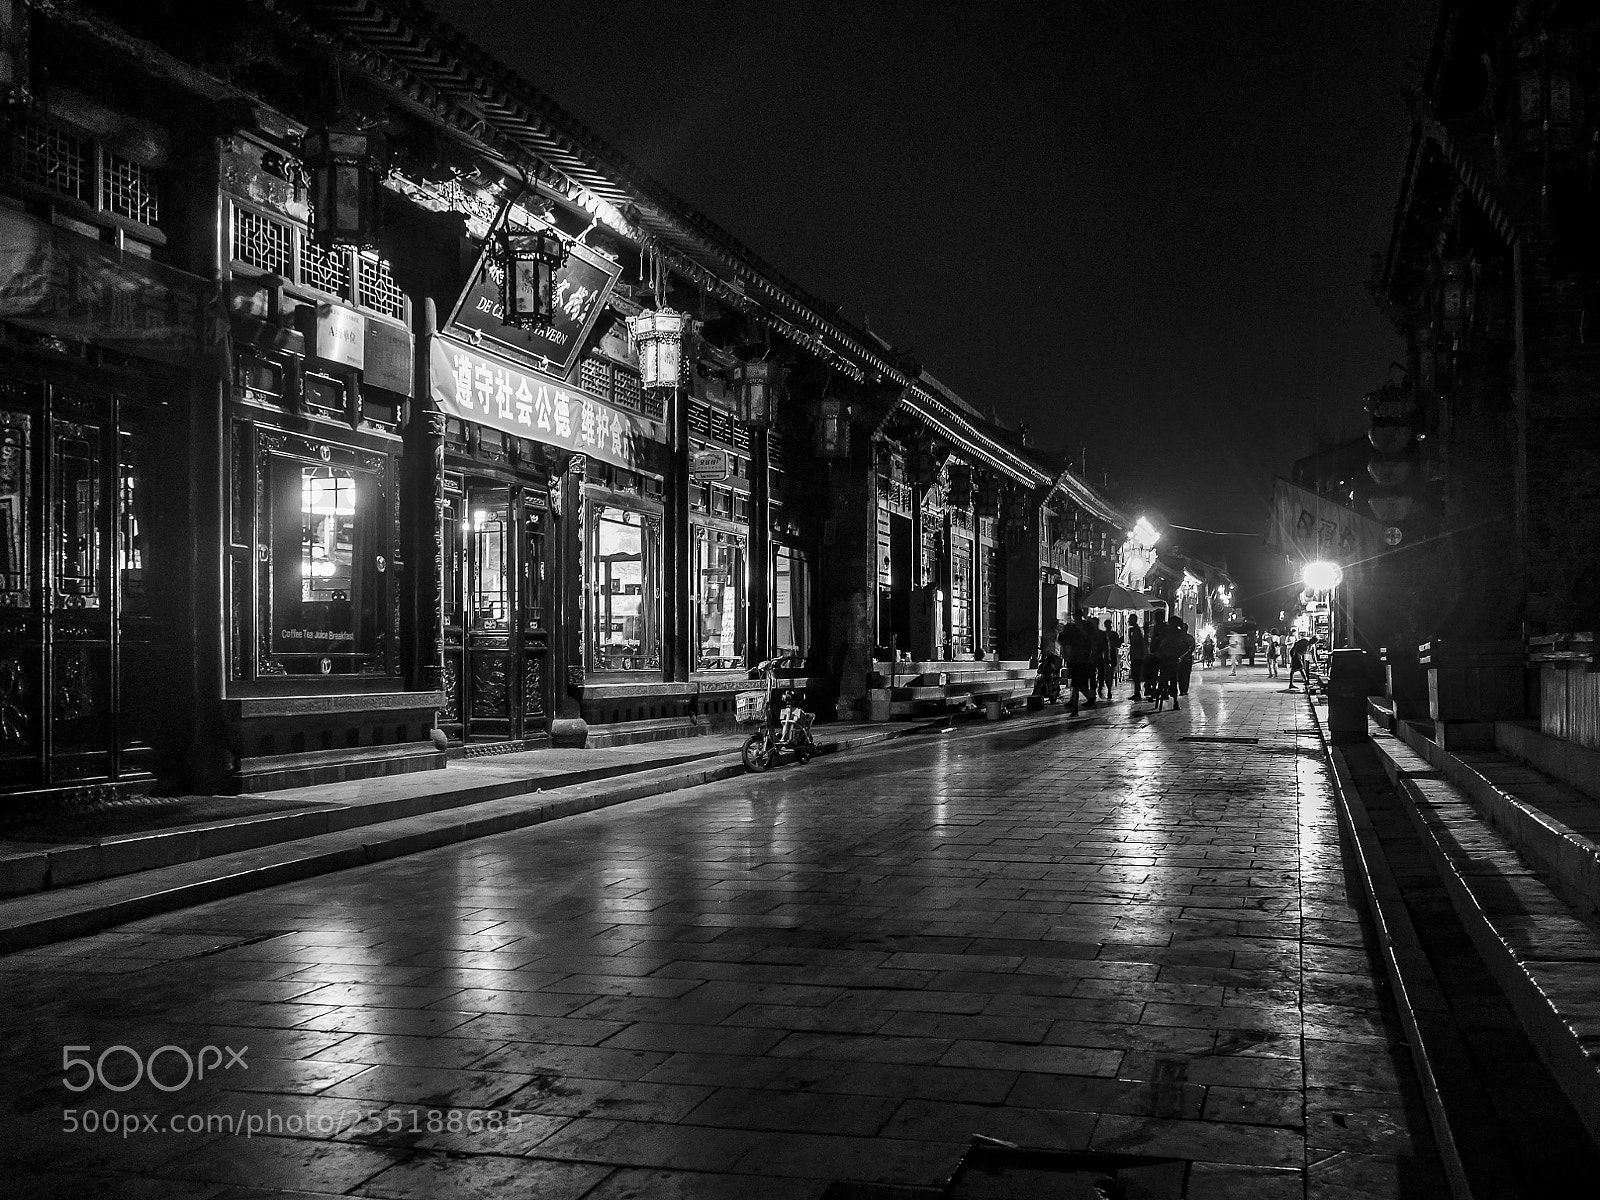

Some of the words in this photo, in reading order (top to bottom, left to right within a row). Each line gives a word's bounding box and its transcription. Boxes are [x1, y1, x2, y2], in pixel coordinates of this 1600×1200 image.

[475, 296, 494, 314] DE
[452, 353, 572, 439] 遵守社会公德
[281, 628, 303, 640] Coffee
[302, 628, 314, 639] Tea
[314, 629, 328, 640] Juice
[328, 630, 354, 641] Breakfast
